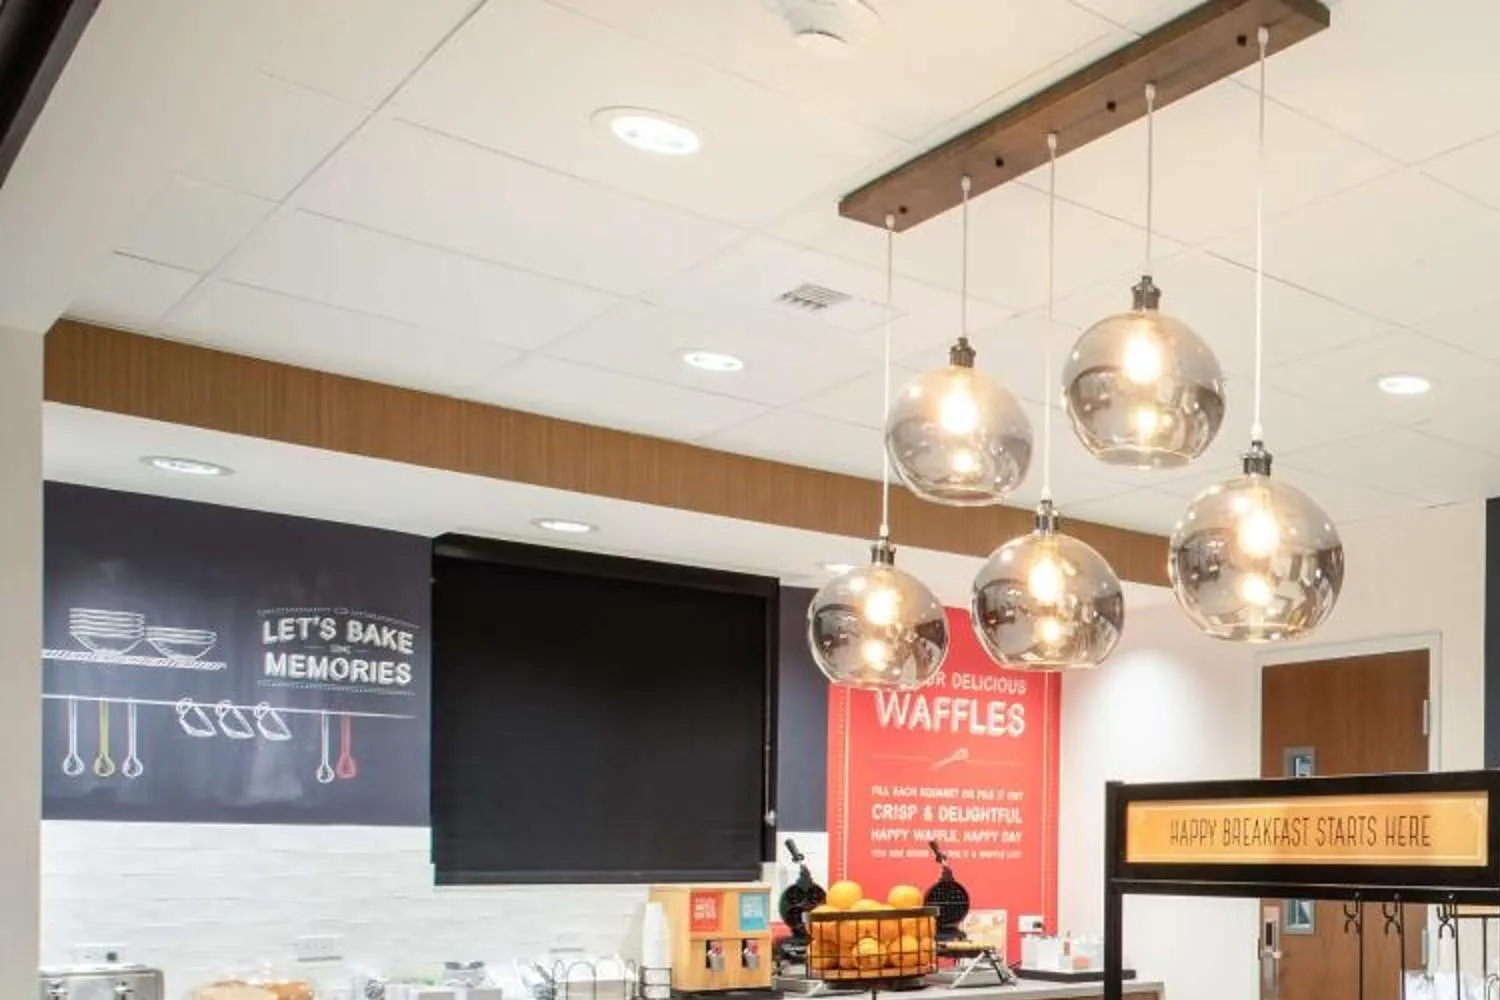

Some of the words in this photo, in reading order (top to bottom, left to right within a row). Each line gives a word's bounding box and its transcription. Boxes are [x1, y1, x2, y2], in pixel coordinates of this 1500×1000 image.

[263, 617, 336, 644] LET'S
[347, 619, 414, 654] BAKE
[264, 652, 411, 685] MEMORIES
[952, 672, 1027, 695] DELICIOUS
[875, 690, 1025, 738] WAFFLES
[871, 803, 918, 821] CRISP
[922, 805, 934, 822] &
[938, 805, 1023, 825] DELIGHTFUL
[871, 829, 907, 842] HAPPY
[963, 830, 998, 843] HAPPY
[1002, 831, 1023, 843] DAY
[1170, 819, 1218, 847] HAPPY
[1223, 817, 1310, 847] BREAKFAST
[1316, 816, 1377, 847] STARTS
[1385, 815, 1432, 847] HERE
